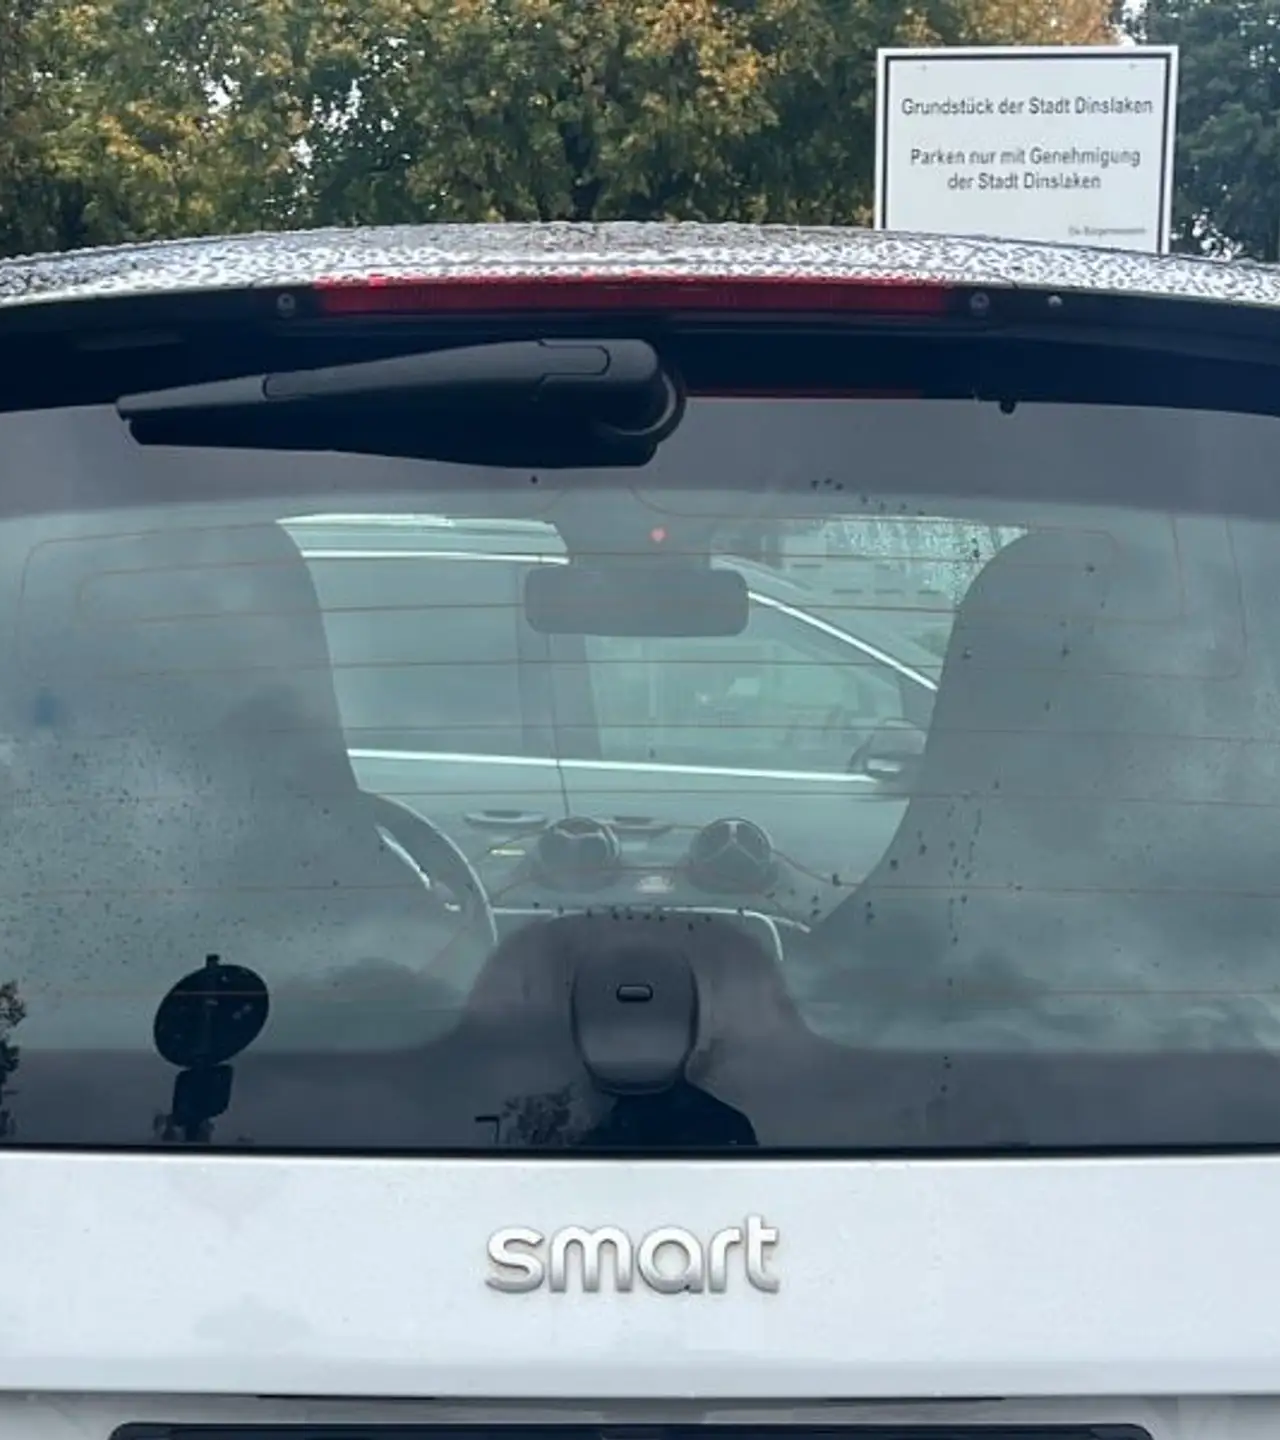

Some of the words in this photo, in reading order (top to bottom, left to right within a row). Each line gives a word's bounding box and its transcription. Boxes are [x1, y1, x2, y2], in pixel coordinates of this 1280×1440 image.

[901, 98, 995, 115] Grundstück
[998, 98, 1024, 115] der
[1028, 96, 1071, 114] Stadt
[1075, 97, 1153, 114] Dinslaken
[911, 149, 966, 165] Parken
[969, 150, 996, 164] nur
[1000, 149, 1025, 165] mit
[1029, 147, 1141, 168] Genehmigung
[947, 173, 973, 190] der
[978, 172, 1019, 190] Stadt
[1024, 173, 1101, 189] Dinslaken
[484, 1213, 780, 1294] smart
